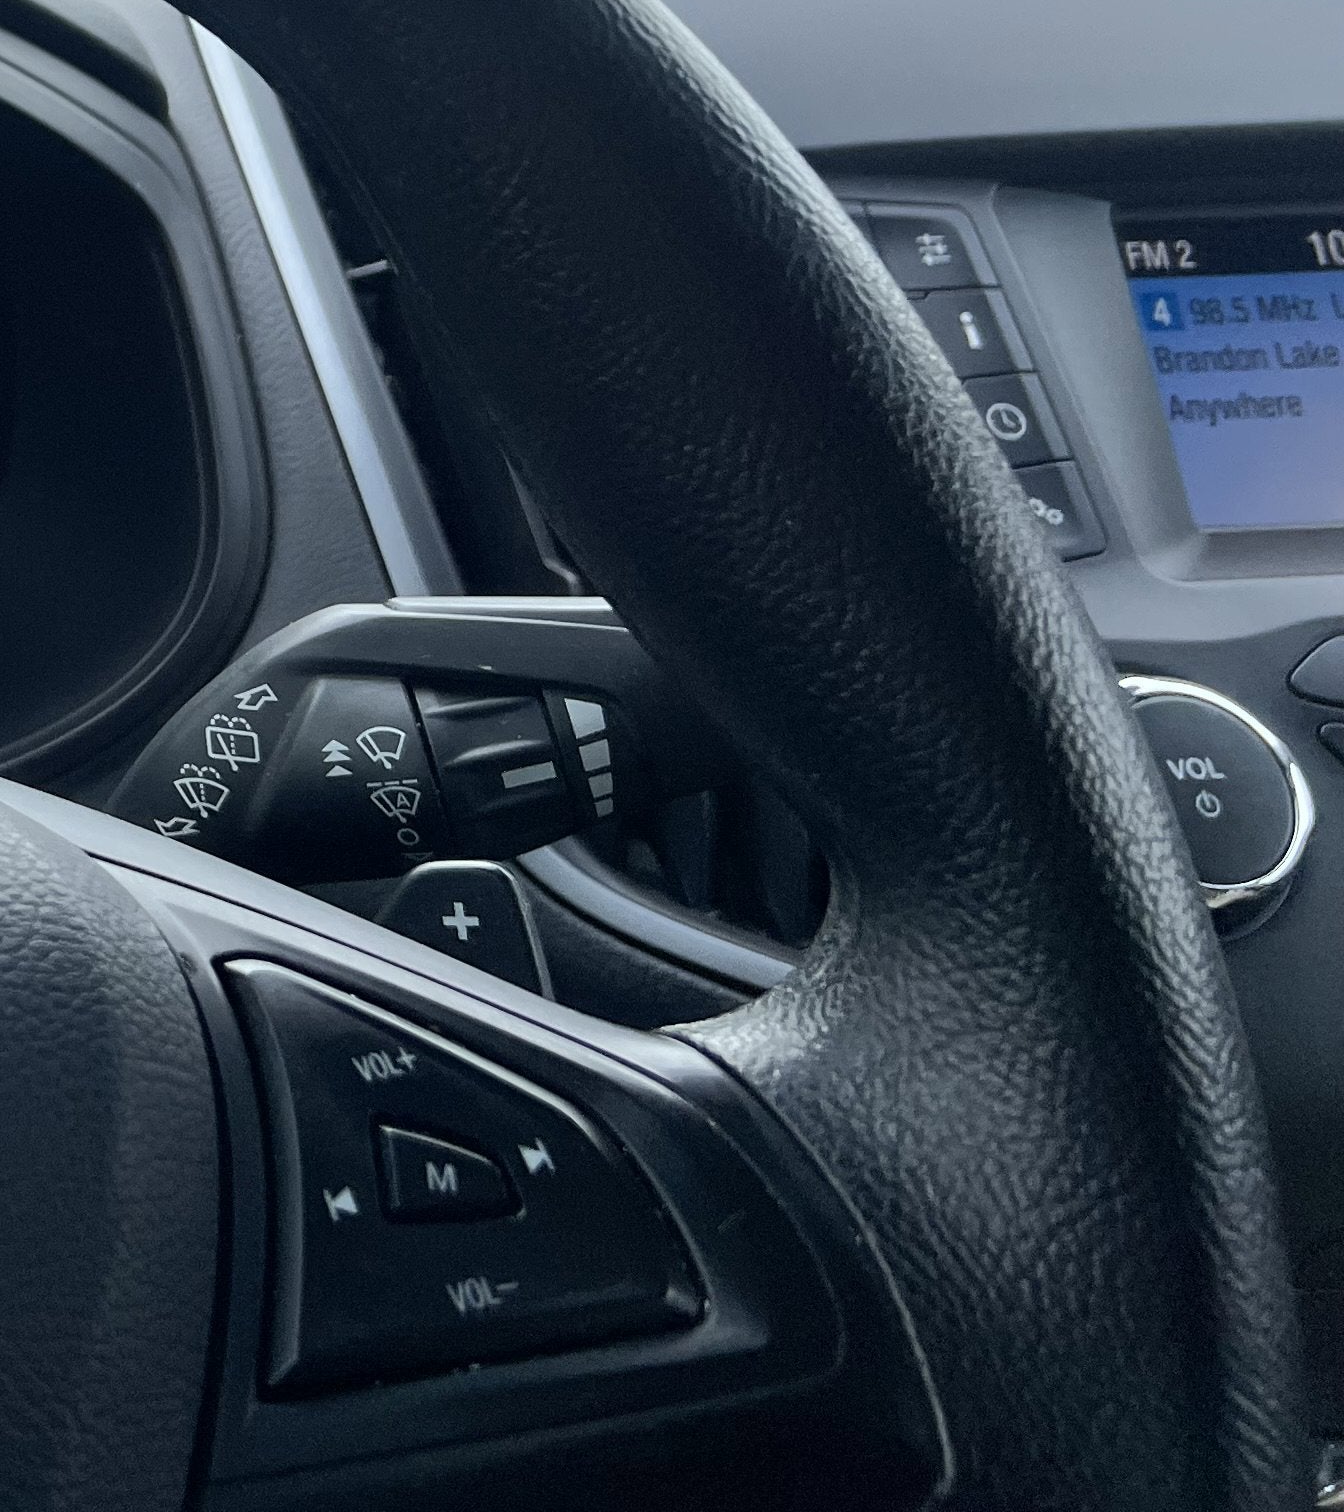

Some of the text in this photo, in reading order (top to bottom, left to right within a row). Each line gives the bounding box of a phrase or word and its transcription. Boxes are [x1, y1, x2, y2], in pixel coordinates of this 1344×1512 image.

[1125, 239, 1197, 271] FM 2
[1153, 296, 1171, 327] 4
[1154, 340, 1341, 375] Brandon Lake
[1170, 392, 1305, 427] Anywhere
[1166, 756, 1226, 781] VOL
[425, 1160, 460, 1193] M
